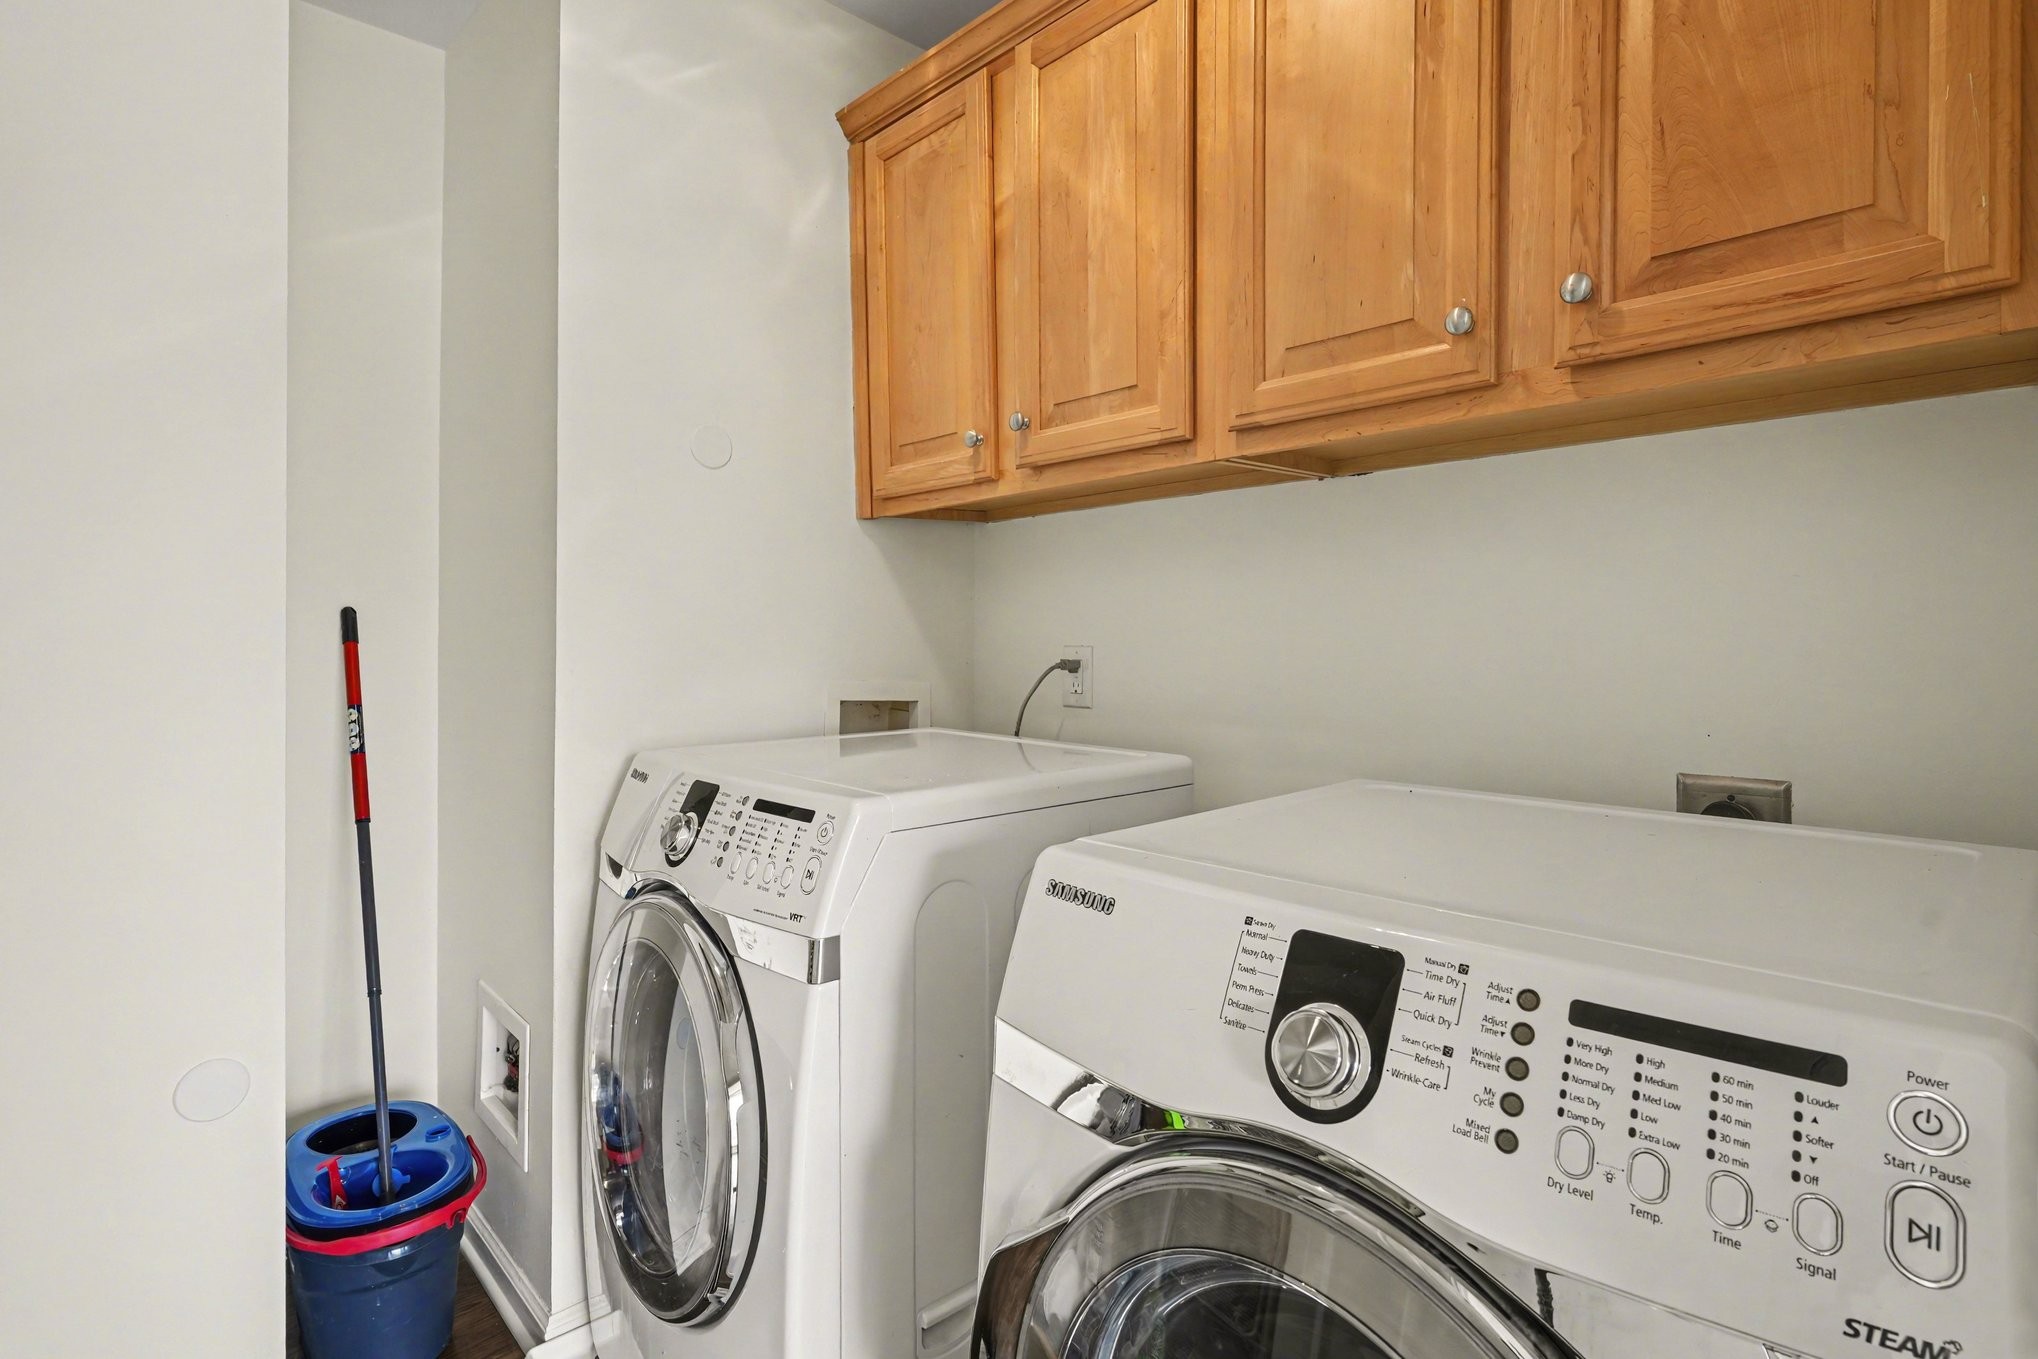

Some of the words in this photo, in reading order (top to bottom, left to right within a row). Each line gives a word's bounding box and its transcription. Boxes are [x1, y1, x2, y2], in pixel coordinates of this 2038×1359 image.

[1045, 878, 1116, 915] SAMSUNG
[789, 912, 804, 923] VRT
[1246, 929, 1268, 941] Normal
[1241, 946, 1260, 959] Heavy
[1260, 950, 1275, 963] Duty
[1237, 963, 1258, 976] Towels
[1232, 980, 1248, 992] Perm
[1248, 985, 1264, 996] Press
[1425, 970, 1444, 983] Time
[1446, 975, 1460, 989] Dry
[1488, 982, 1514, 995] Adjust
[1228, 998, 1255, 1014] Delicates
[1424, 991, 1436, 1002] Air
[1438, 994, 1457, 1007] Fluff
[1486, 991, 1504, 1004] Time
[1223, 1016, 1247, 1030] Sanitize
[1413, 1009, 1436, 1024] Quick
[1438, 1015, 1452, 1030] Dry
[1482, 1014, 1508, 1028] Adjust
[1480, 1024, 1500, 1037] Time
[1471, 1047, 1502, 1062] Wrinkle
[1576, 1040, 1592, 1054] Very
[1594, 1044, 1612, 1056] High
[1414, 1052, 1445, 1070] Refresh
[1470, 1056, 1500, 1073] Prevent
[1574, 1057, 1594, 1070] More
[1596, 1063, 1610, 1076] Dry
[1646, 1056, 1666, 1070] High
[1572, 1074, 1600, 1090] Normal
[1601, 1082, 1616, 1096] Dry
[1644, 1074, 1679, 1092] Medium
[1722, 1074, 1735, 1086] 60
[1736, 1080, 1754, 1091] min
[1906, 1070, 1950, 1092] Power
[1483, 1086, 1496, 1098] My
[1473, 1094, 1494, 1108] Cycle
[1569, 1092, 1586, 1104] Less
[1586, 1097, 1601, 1110] Dry
[1642, 1093, 1662, 1106] Med
[1663, 1098, 1682, 1112] Low
[1722, 1093, 1734, 1105] 50
[1735, 1098, 1754, 1110] min
[1806, 1094, 1840, 1112] Louder
[1466, 1118, 1491, 1134] Mixed
[1566, 1110, 1590, 1125] Damp
[1591, 1116, 1606, 1130] Dry
[1640, 1112, 1659, 1125] Low
[1720, 1113, 1733, 1124] 40
[1734, 1118, 1752, 1130] min
[1452, 1124, 1472, 1140] Load
[1474, 1130, 1490, 1144] Bell
[1638, 1130, 1660, 1146] Extra
[1662, 1137, 1681, 1150] Low
[1719, 1132, 1732, 1144] 30
[1732, 1138, 1751, 1150] min
[1804, 1134, 1836, 1150] Softer
[1718, 1152, 1730, 1164] 20
[1732, 1158, 1750, 1170] min
[1883, 1152, 1917, 1174] Start
[1929, 1164, 1972, 1189] Pause
[1547, 1176, 1564, 1194] Dry
[1567, 1182, 1594, 1201] Level
[1804, 1174, 1820, 1187] Off
[1630, 1203, 1664, 1225] Temp.
[1712, 1229, 1742, 1250] Time
[1796, 1256, 1838, 1282] Signal
[1842, 1318, 1951, 1359] STEAM
